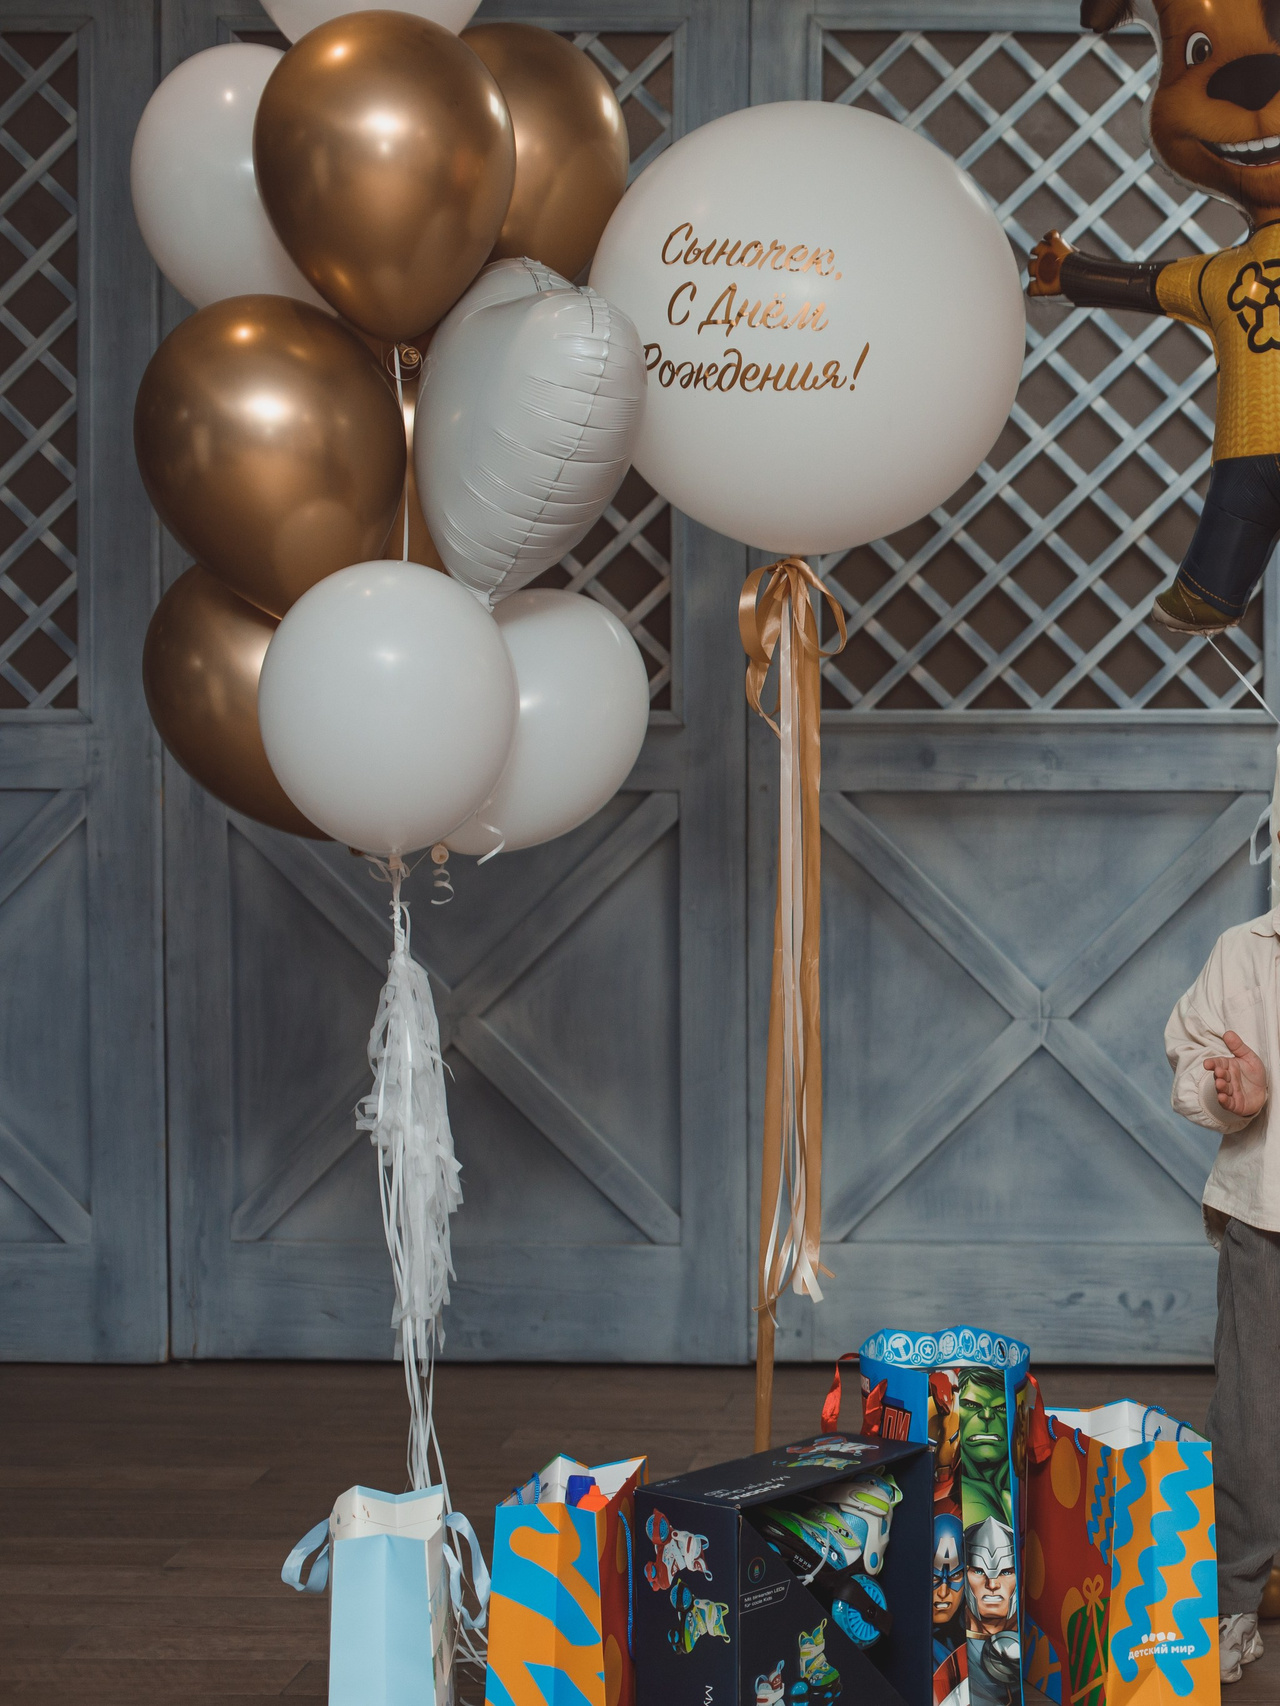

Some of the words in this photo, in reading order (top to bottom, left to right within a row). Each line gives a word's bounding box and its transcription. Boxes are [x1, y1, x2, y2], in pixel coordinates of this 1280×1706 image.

[667, 281, 697, 326] С
[697, 282, 829, 337] Днём
[1128, 1643, 1168, 1661] детский
[1170, 1644, 1196, 1656] мир
